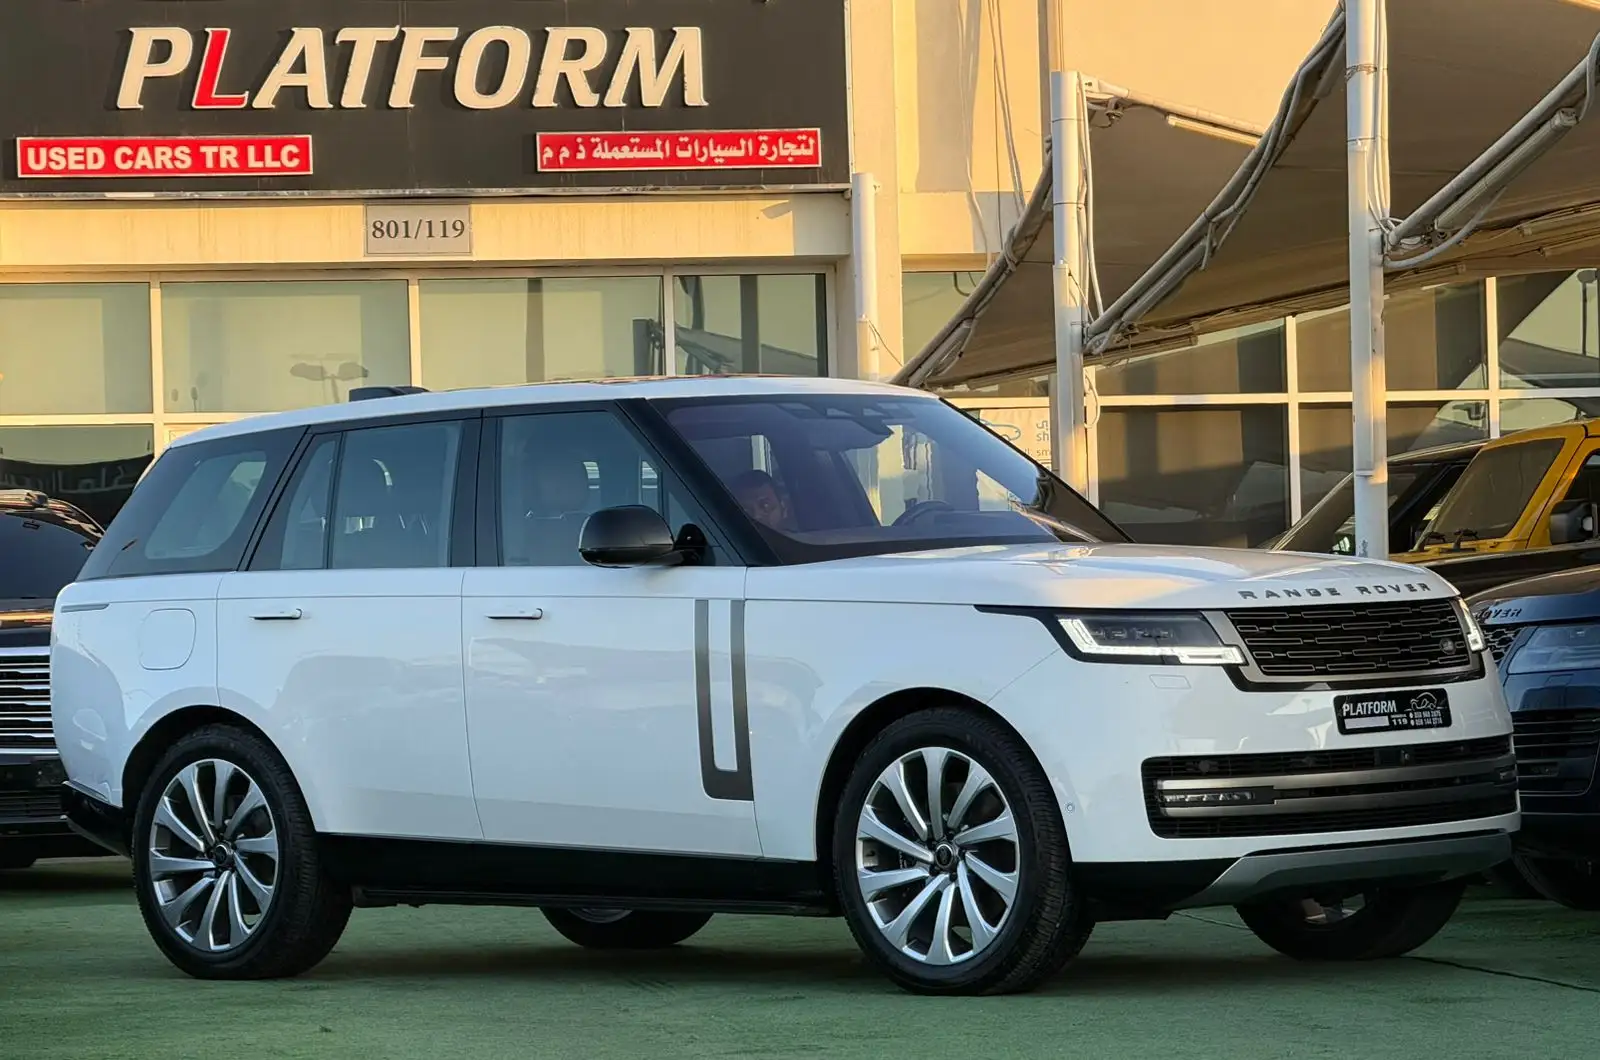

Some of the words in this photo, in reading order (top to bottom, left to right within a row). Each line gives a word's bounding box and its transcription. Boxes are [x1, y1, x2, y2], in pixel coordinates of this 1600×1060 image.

[116, 25, 709, 109] PLATFORM
[27, 147, 105, 170] USED
[114, 146, 192, 170] CARS
[200, 146, 239, 169] TR
[247, 145, 300, 168] LLC
[590, 138, 670, 160] المستعملة
[676, 136, 753, 163] السيارات
[757, 134, 815, 162] لتجارة
[372, 219, 465, 239] 801/119
[1238, 587, 1342, 600] RANGE
[1355, 582, 1431, 595] ROVER
[1342, 700, 1397, 716] PLATFORM
